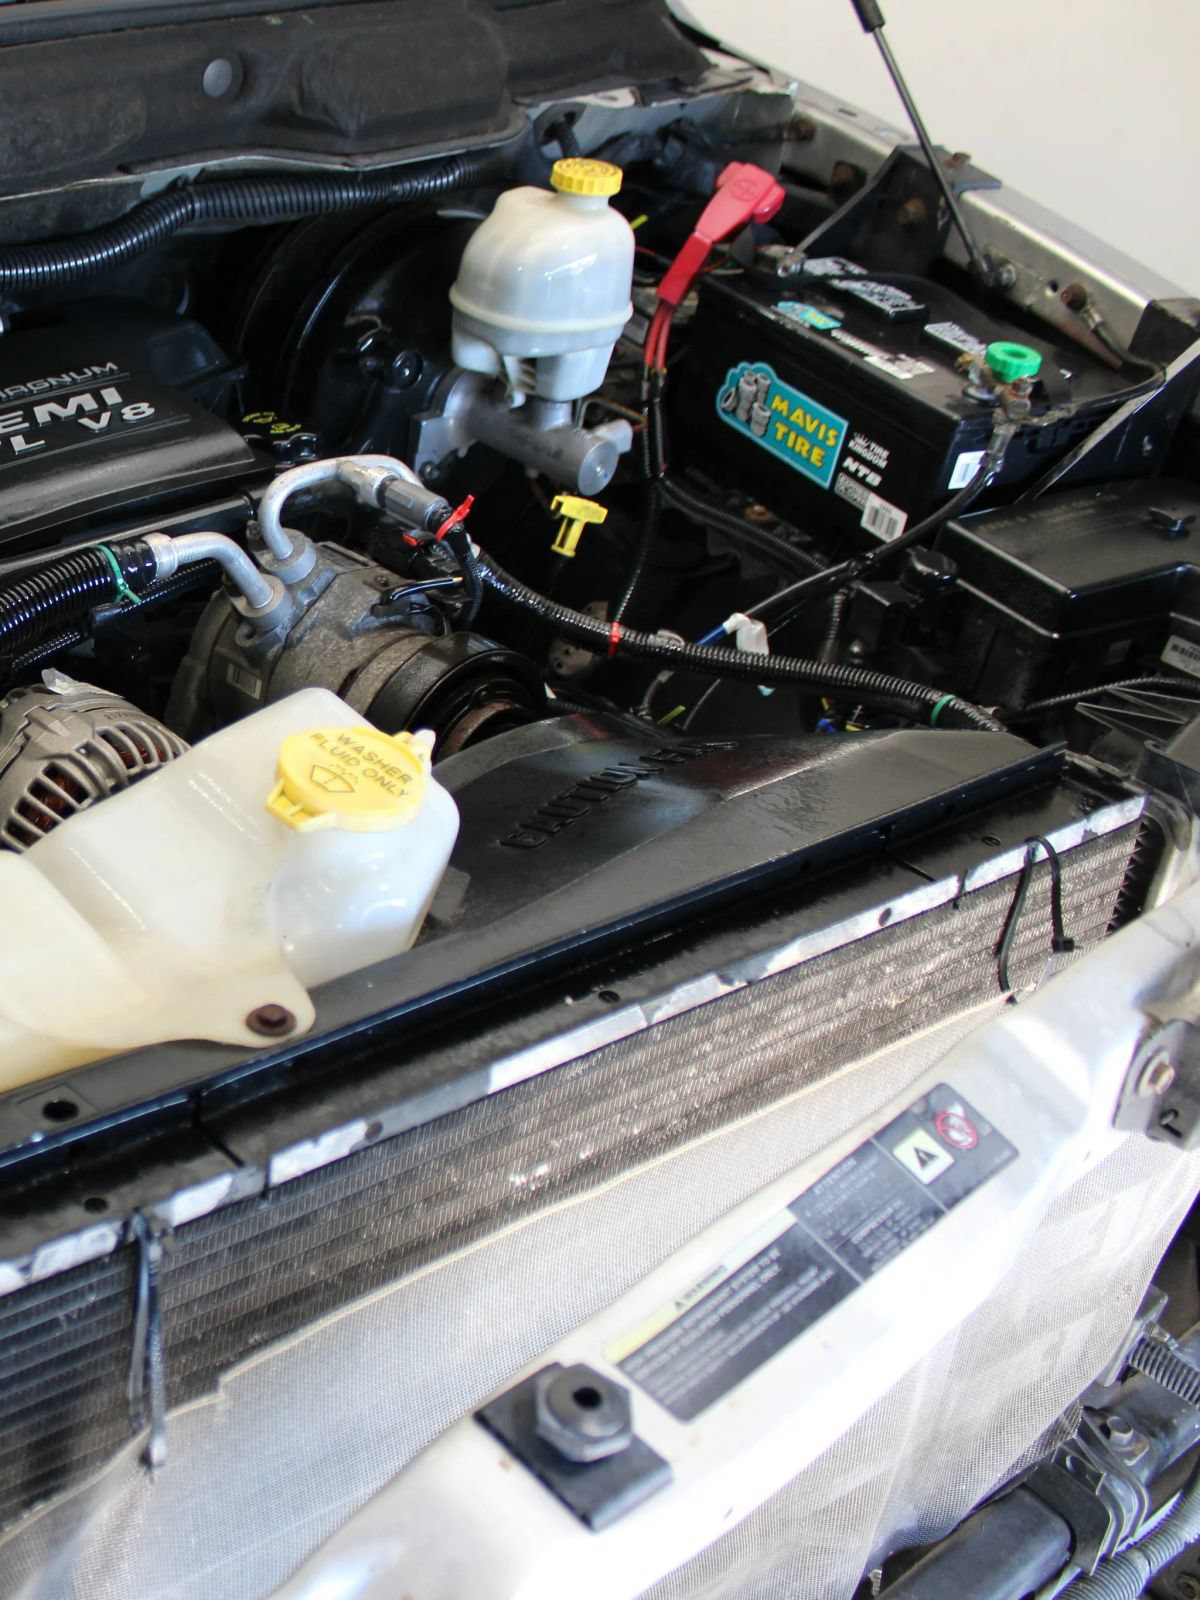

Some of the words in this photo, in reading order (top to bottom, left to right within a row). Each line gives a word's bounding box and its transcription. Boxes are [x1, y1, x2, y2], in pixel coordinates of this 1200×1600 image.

[77, 401, 156, 432] V8
[770, 394, 838, 449] MAVIS
[774, 421, 827, 469] TIRE
[847, 439, 888, 470] KINGDOM
[869, 441, 890, 460] TIRE
[842, 456, 883, 487] NTB
[310, 732, 361, 767] FLUID
[362, 767, 409, 798] ONLY
[337, 733, 414, 785] WASHER
